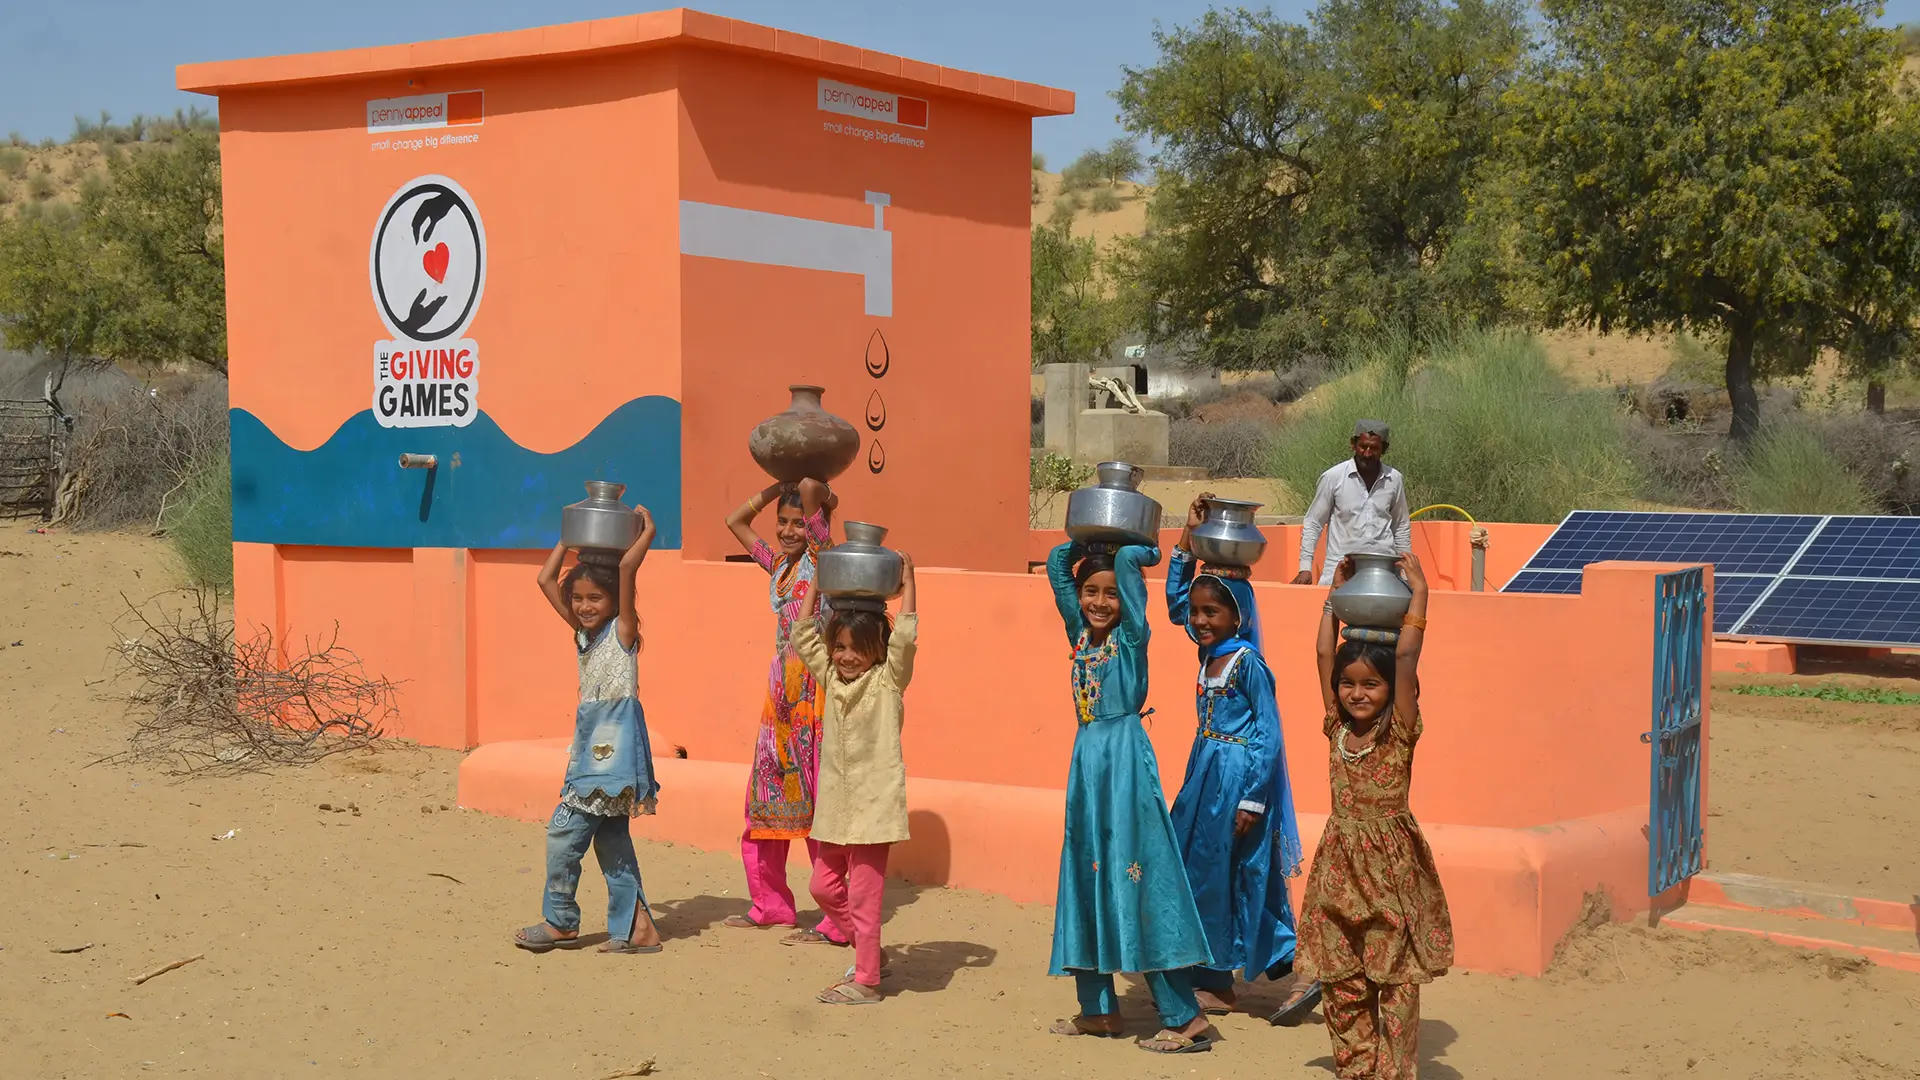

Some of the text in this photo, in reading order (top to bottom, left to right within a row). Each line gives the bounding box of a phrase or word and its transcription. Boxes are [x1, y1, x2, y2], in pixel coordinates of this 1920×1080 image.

[824, 88, 893, 113] pennyappeal
[372, 103, 443, 126] pennyappeal
[392, 138, 423, 151] change
[425, 136, 438, 148] big
[440, 133, 479, 145] difference
[844, 123, 874, 142] change
[875, 128, 888, 143] big
[888, 132, 925, 148] difference
[380, 352, 388, 381] THE
[390, 349, 473, 380] GIVING
[379, 383, 469, 417] GAMES
